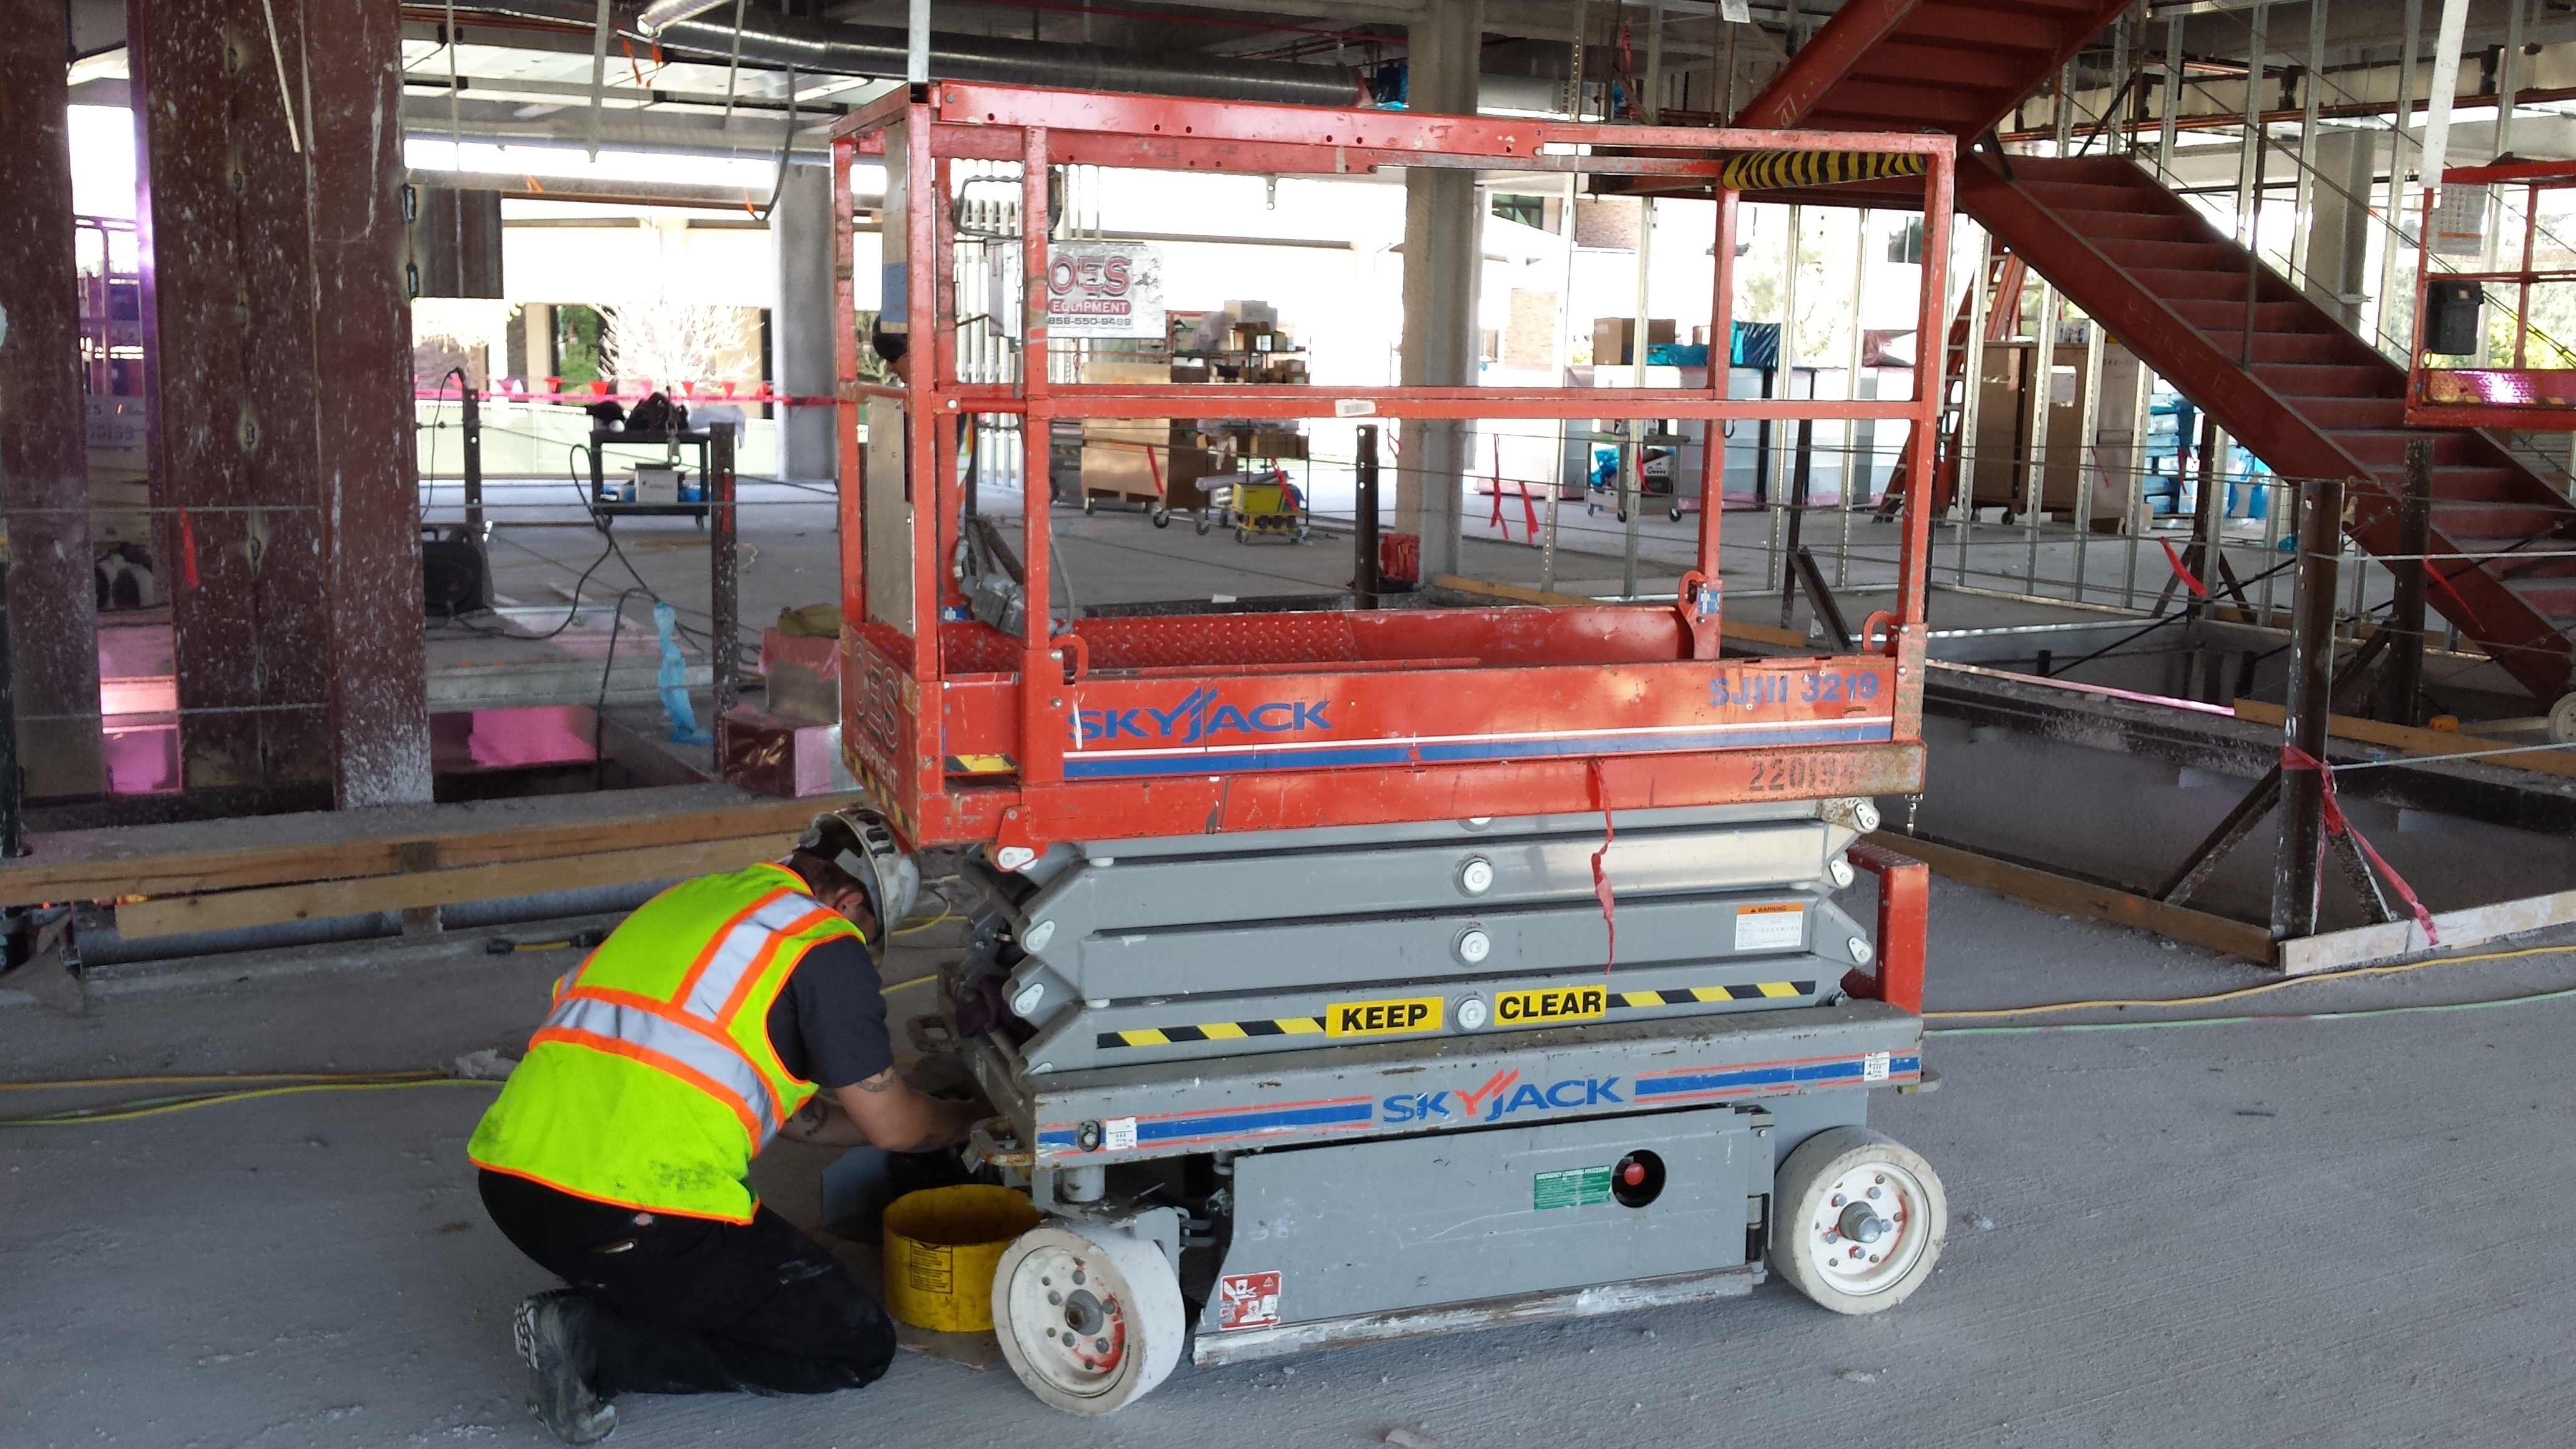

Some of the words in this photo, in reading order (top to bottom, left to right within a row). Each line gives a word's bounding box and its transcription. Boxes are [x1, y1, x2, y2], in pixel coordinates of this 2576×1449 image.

[1048, 254, 1131, 296] OES
[1053, 301, 1128, 313] EQUIPMENT
[1801, 671, 1880, 701] 3219
[1066, 686, 1332, 744] SKYJACK
[1341, 1003, 1428, 1032] KEEP
[1499, 990, 1603, 1020] CLEAR
[1383, 1067, 1624, 1122] SKYJACK
